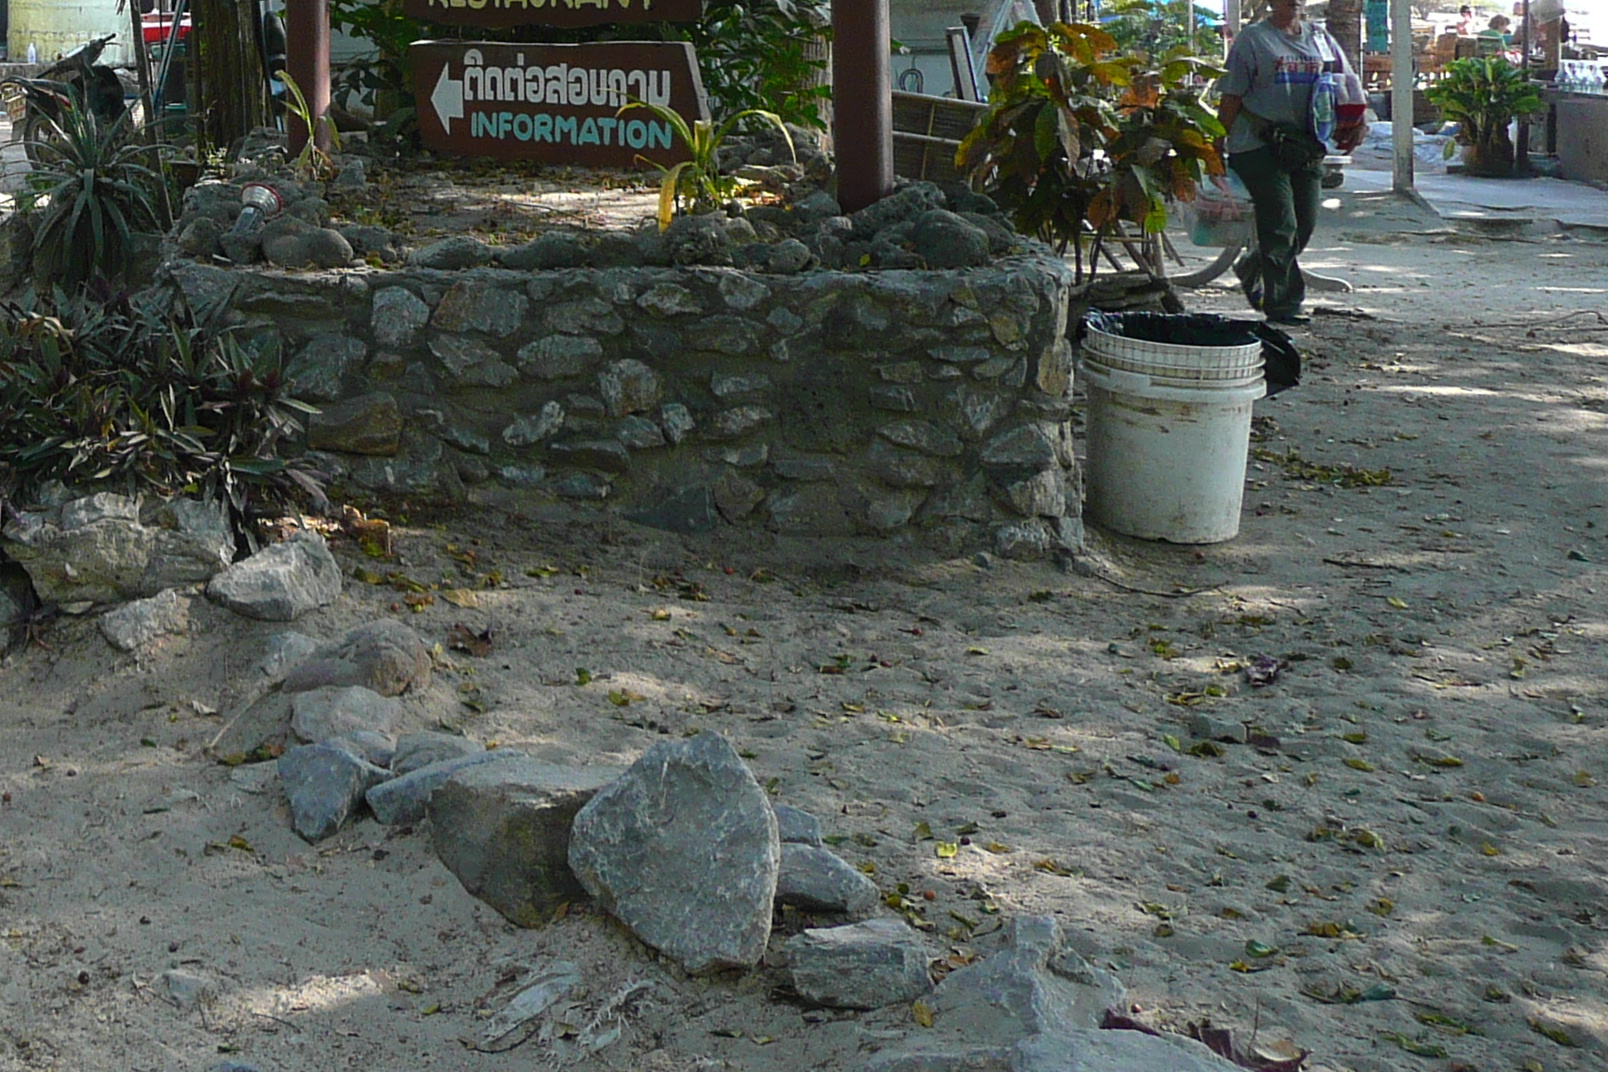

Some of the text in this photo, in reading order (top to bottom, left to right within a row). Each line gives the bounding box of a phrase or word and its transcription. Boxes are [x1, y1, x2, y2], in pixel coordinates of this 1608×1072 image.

[464, 48, 671, 107] ติดต่อสอบถาม
[471, 111, 673, 149] INFORMATION
